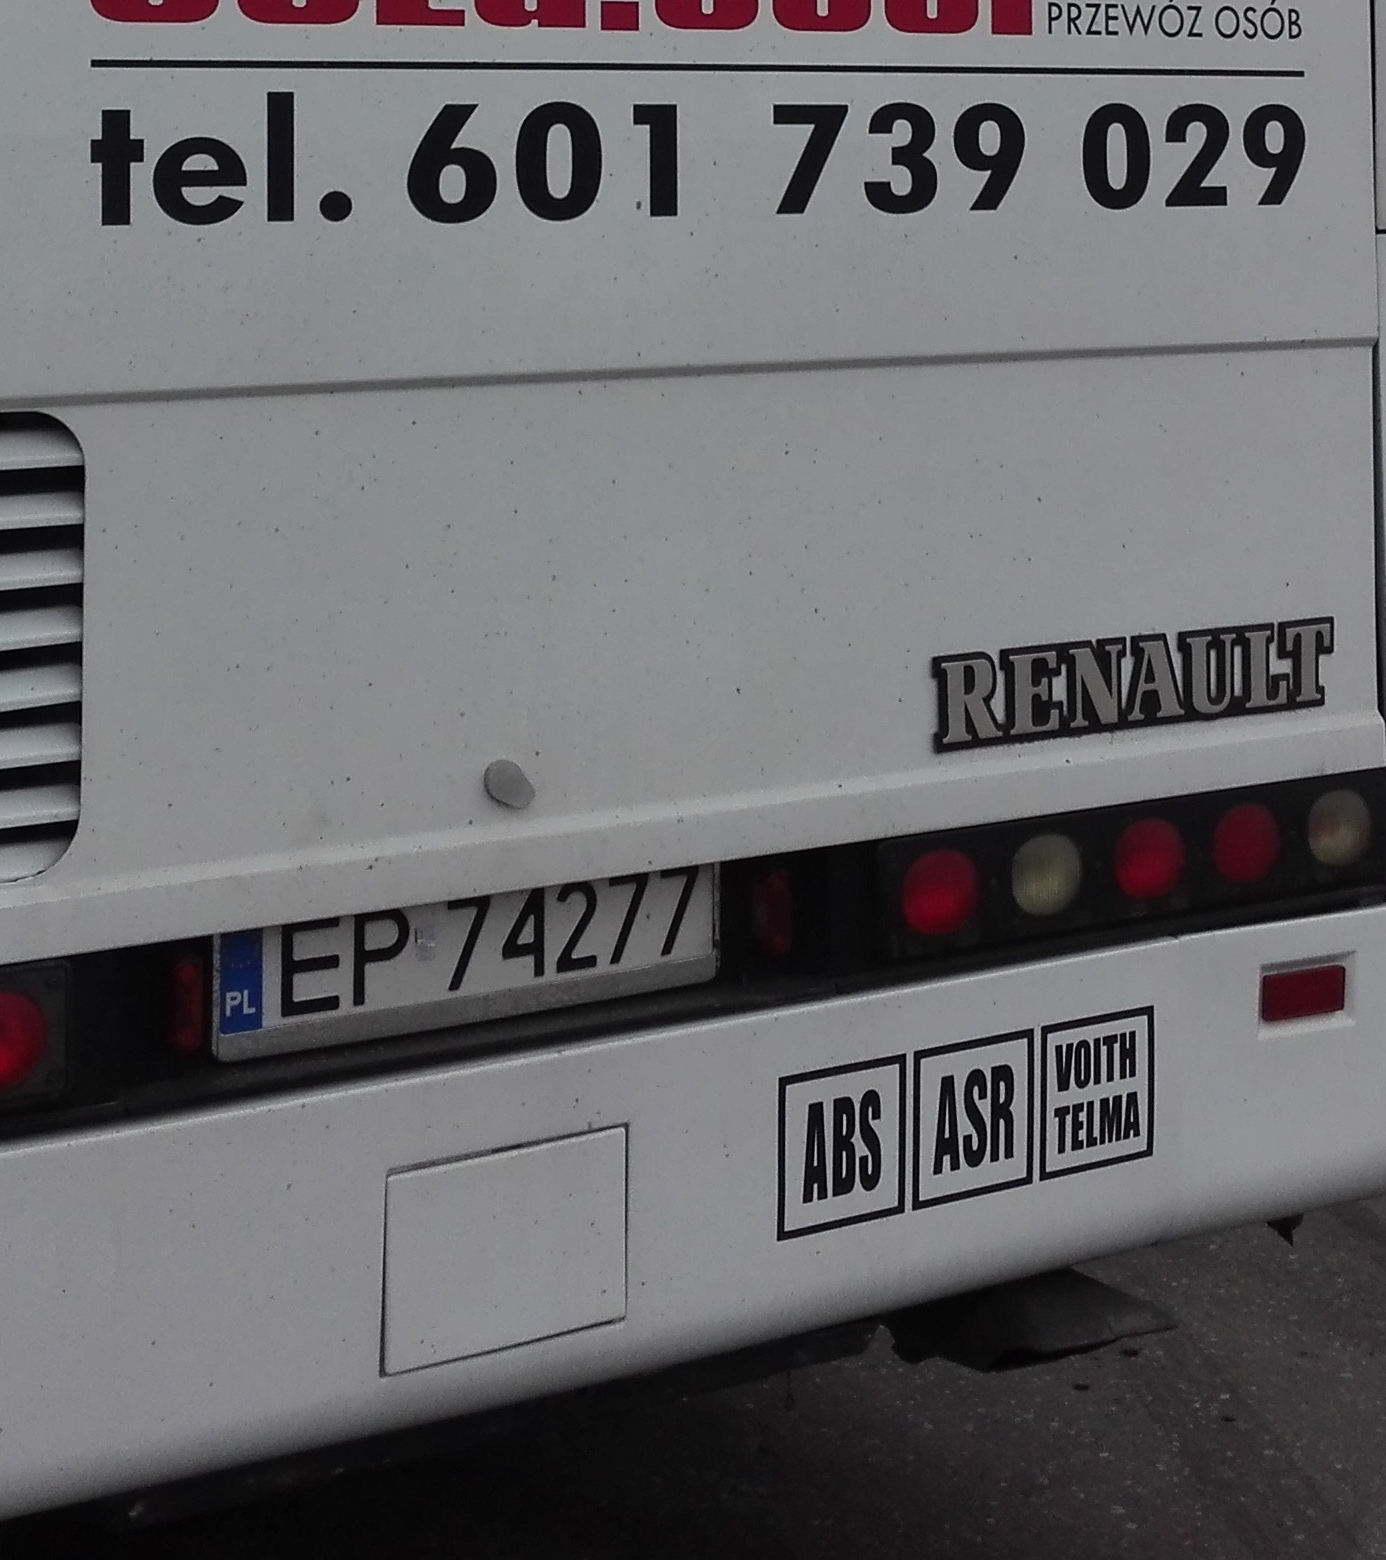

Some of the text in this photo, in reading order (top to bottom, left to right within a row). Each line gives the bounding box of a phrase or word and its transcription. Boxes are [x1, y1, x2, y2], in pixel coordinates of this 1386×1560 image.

[89, 91, 1308, 227] tel. 601 739 029
[933, 616, 1336, 753] RENAULT
[224, 865, 701, 1018] PL EP 74277
[1054, 1030, 1137, 1092] VOITH
[802, 1088, 882, 1204] ABS
[932, 1063, 1015, 1176] ASR
[1053, 1091, 1141, 1155] TELMA
